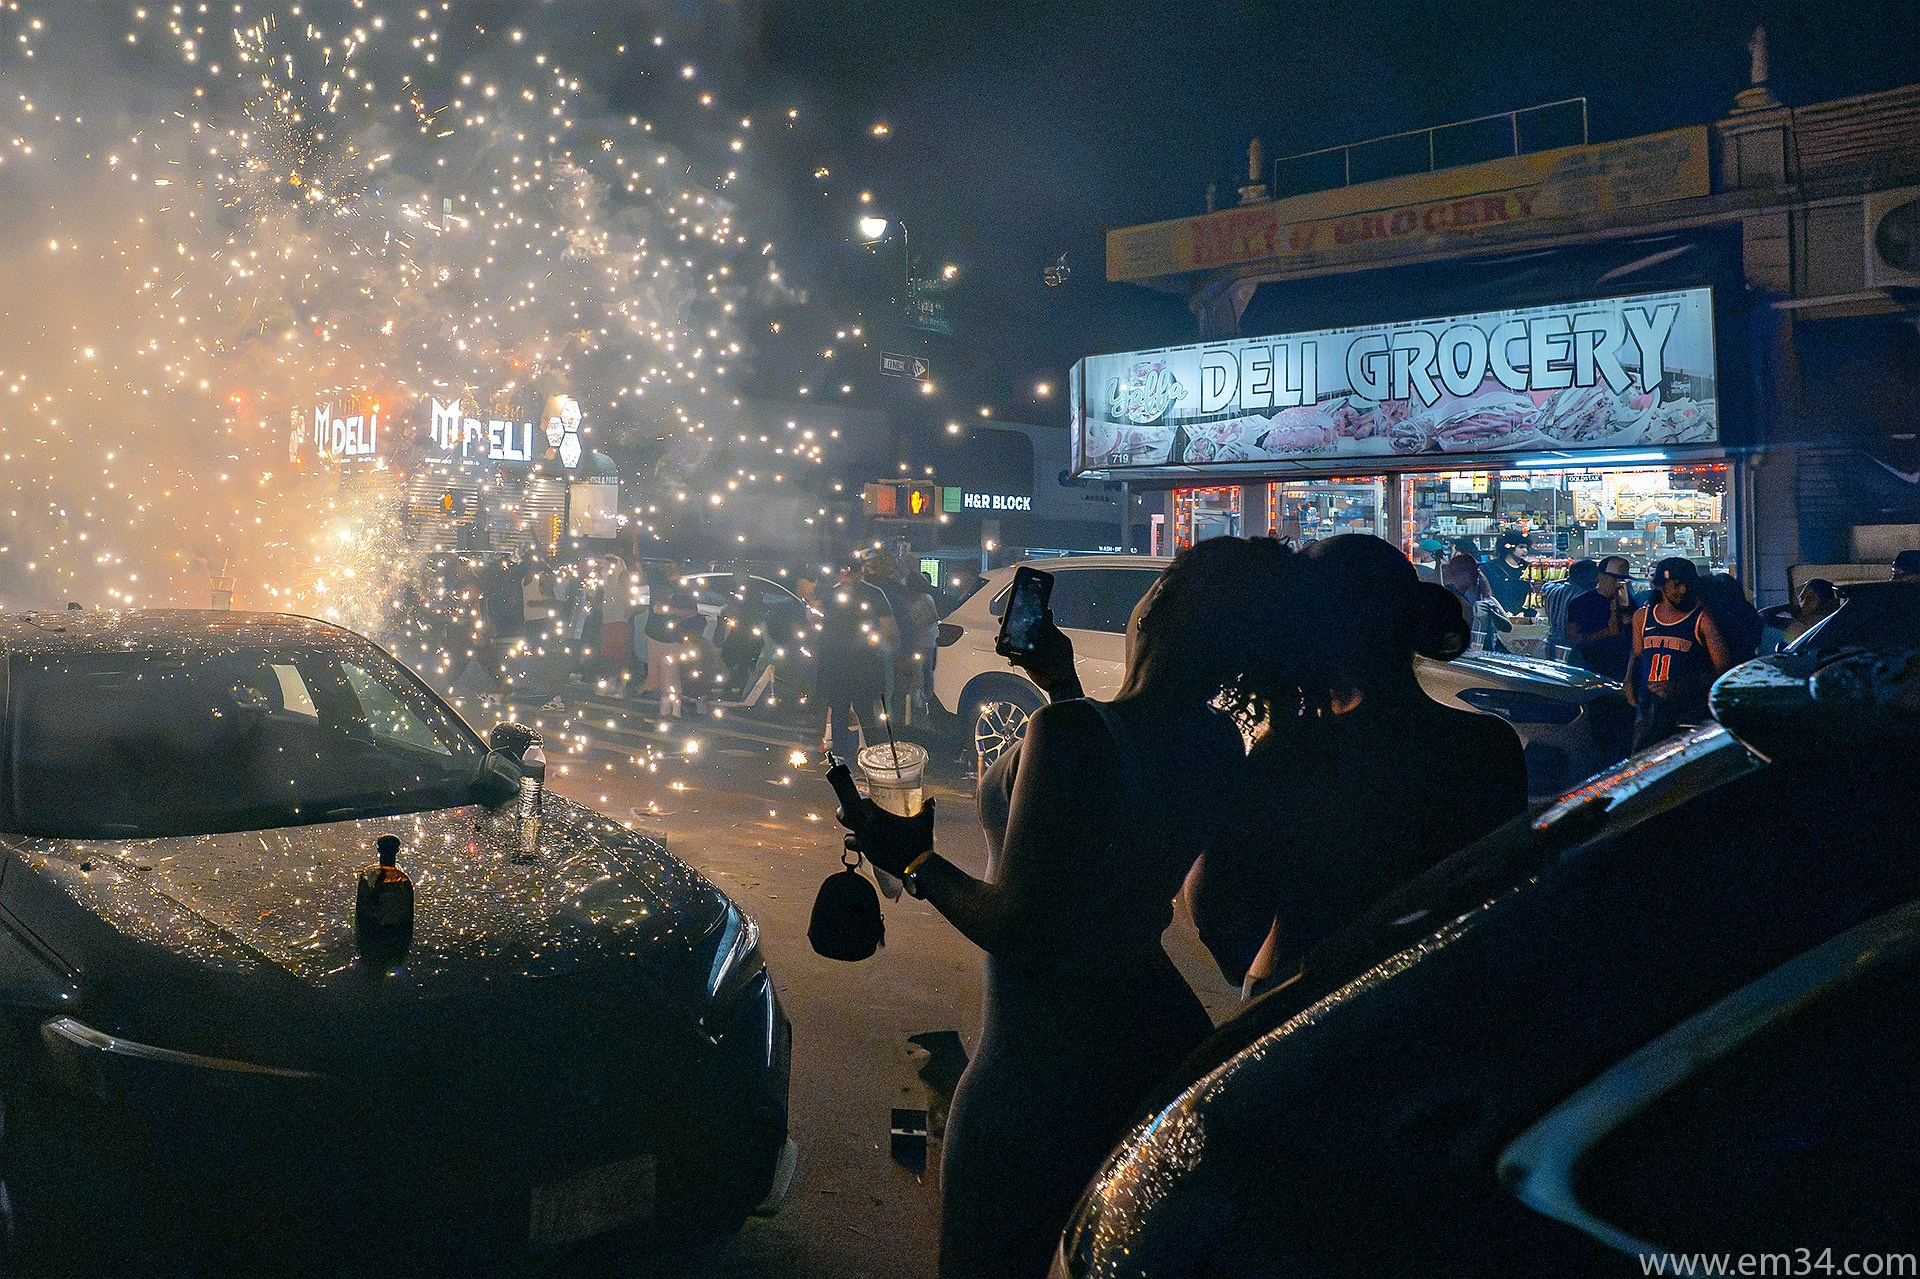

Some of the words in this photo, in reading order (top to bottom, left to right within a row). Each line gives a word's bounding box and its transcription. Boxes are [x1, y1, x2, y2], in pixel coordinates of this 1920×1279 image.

[1200, 341, 1318, 413] DELI
[1346, 302, 1680, 408] GROCERY
[1105, 368, 1188, 423] Yaffa
[332, 414, 377, 455] DELI
[1111, 453, 1129, 463] 719
[964, 493, 990, 509] H&R
[993, 495, 1031, 511] BLOCK
[1648, 653, 1672, 682] 11
